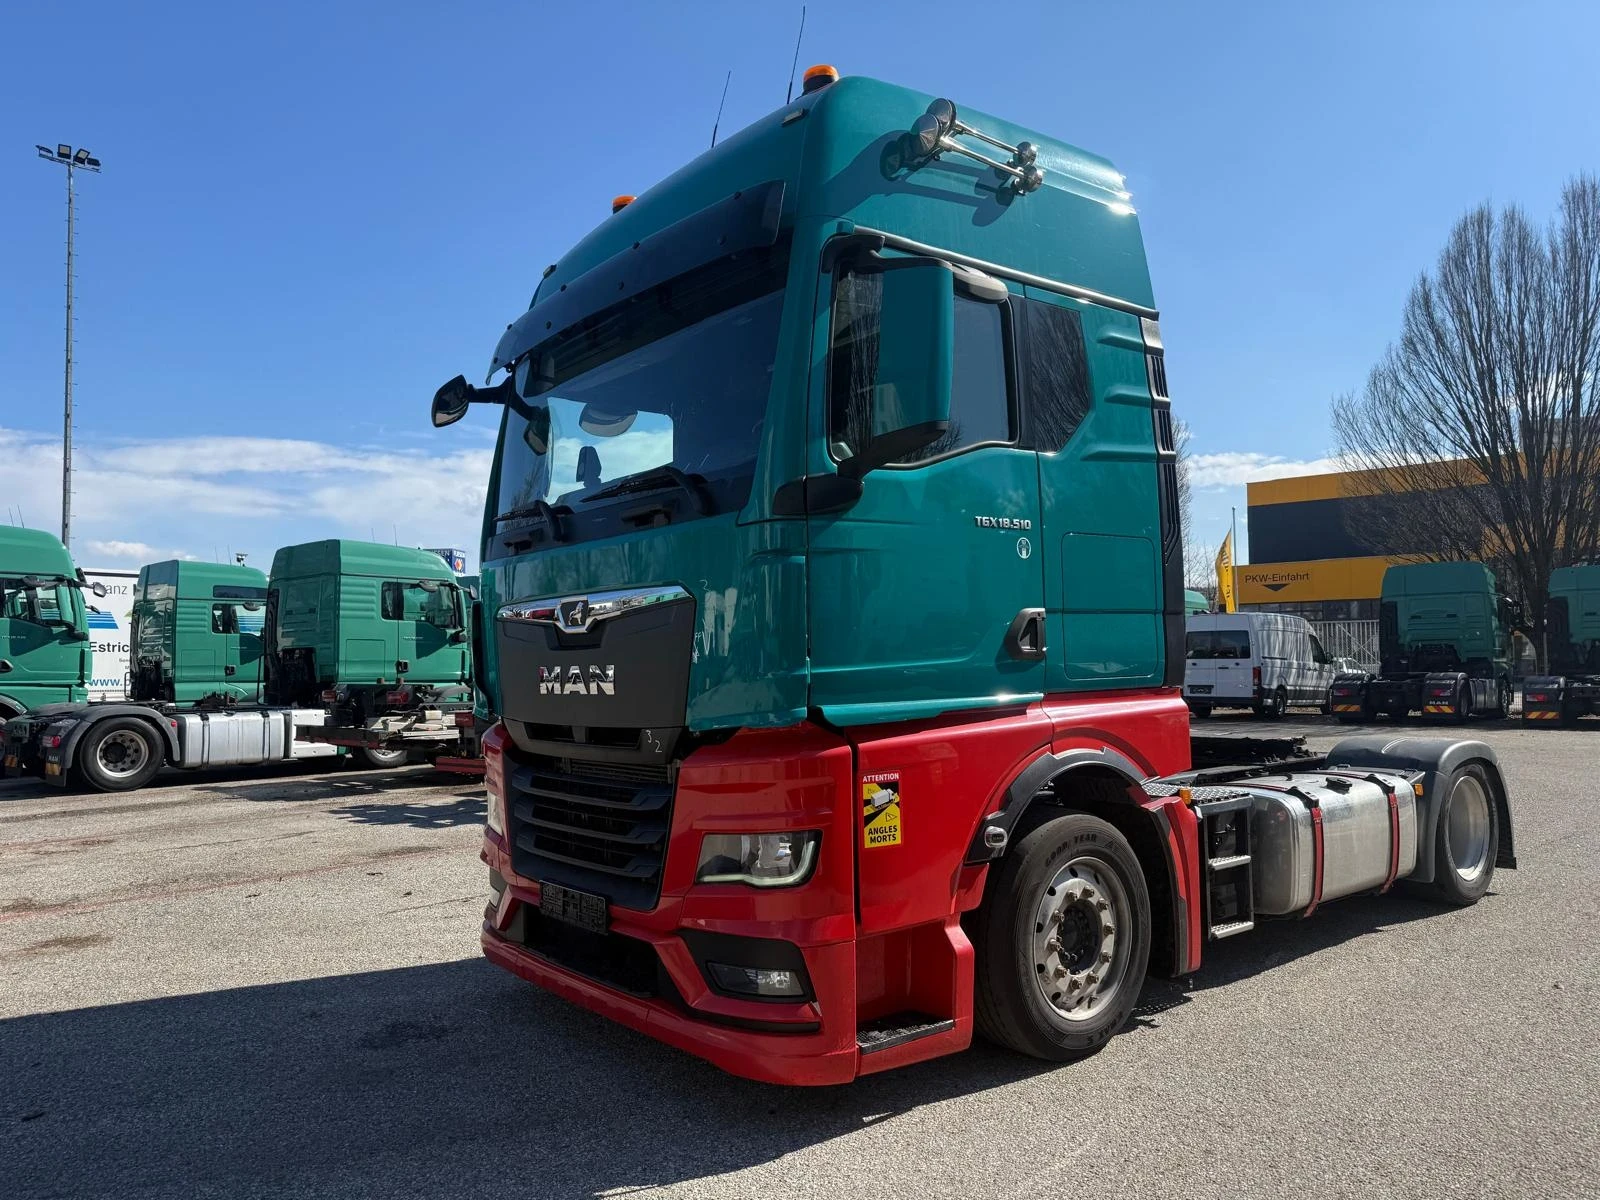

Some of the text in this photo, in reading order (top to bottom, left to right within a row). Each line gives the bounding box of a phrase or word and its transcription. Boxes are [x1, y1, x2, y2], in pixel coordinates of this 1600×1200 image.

[1245, 572, 1309, 583] PKW-Einfahrt
[104, 584, 128, 595] anz
[539, 664, 615, 695] MAN
[862, 772, 900, 783] ATTENTION
[868, 825, 898, 836] ANGLES
[869, 833, 897, 844] MORTS
